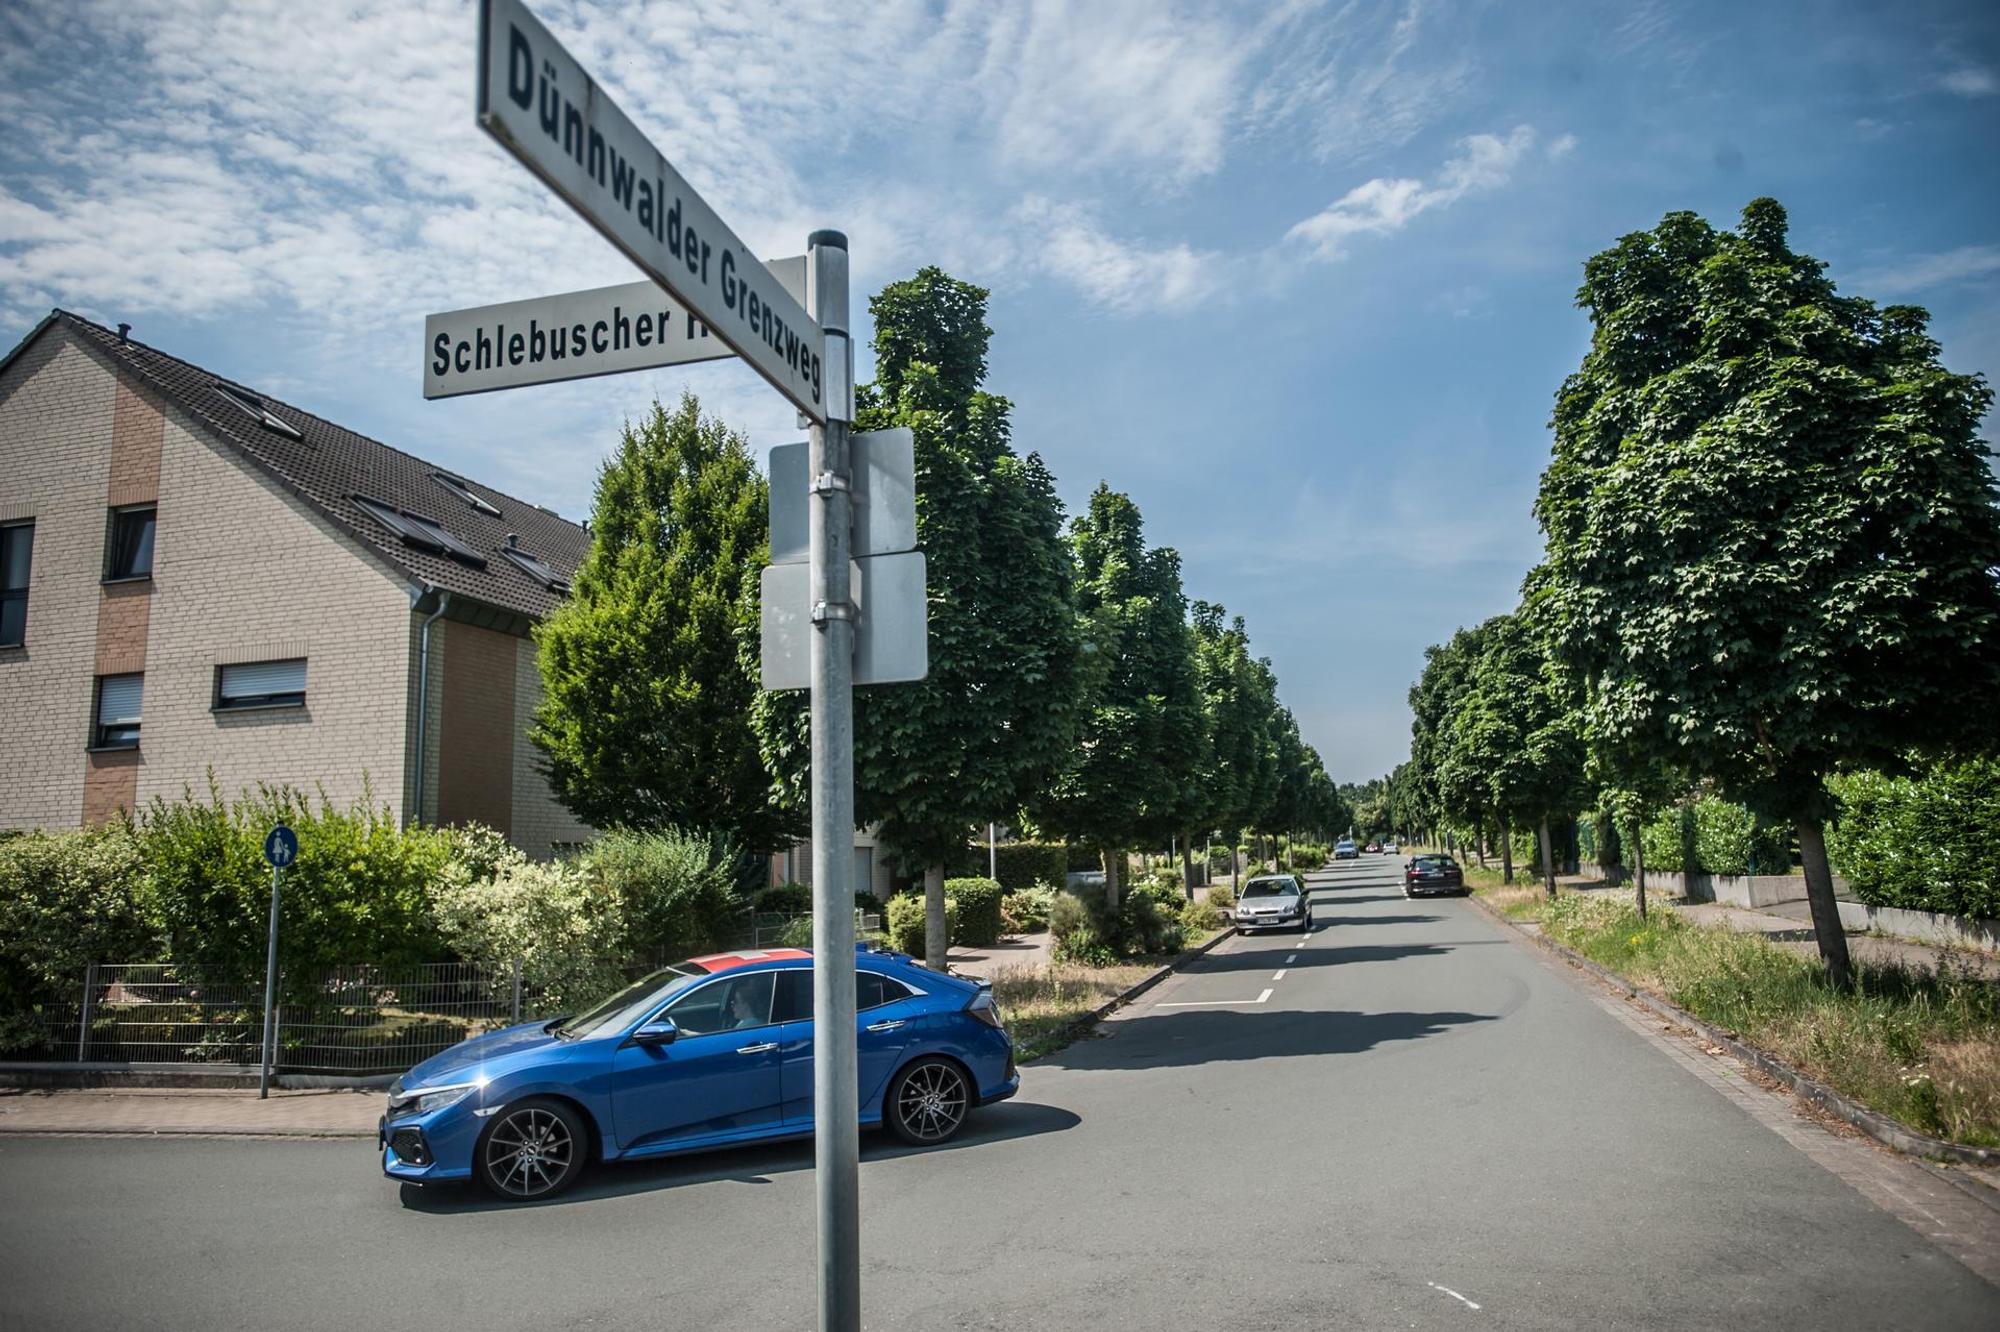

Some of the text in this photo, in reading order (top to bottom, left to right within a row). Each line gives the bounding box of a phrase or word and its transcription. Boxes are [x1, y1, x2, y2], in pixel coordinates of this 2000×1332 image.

[508, 21, 821, 405] Dünnwalder Grenzweg
[432, 306, 671, 377] Schlebuscher
